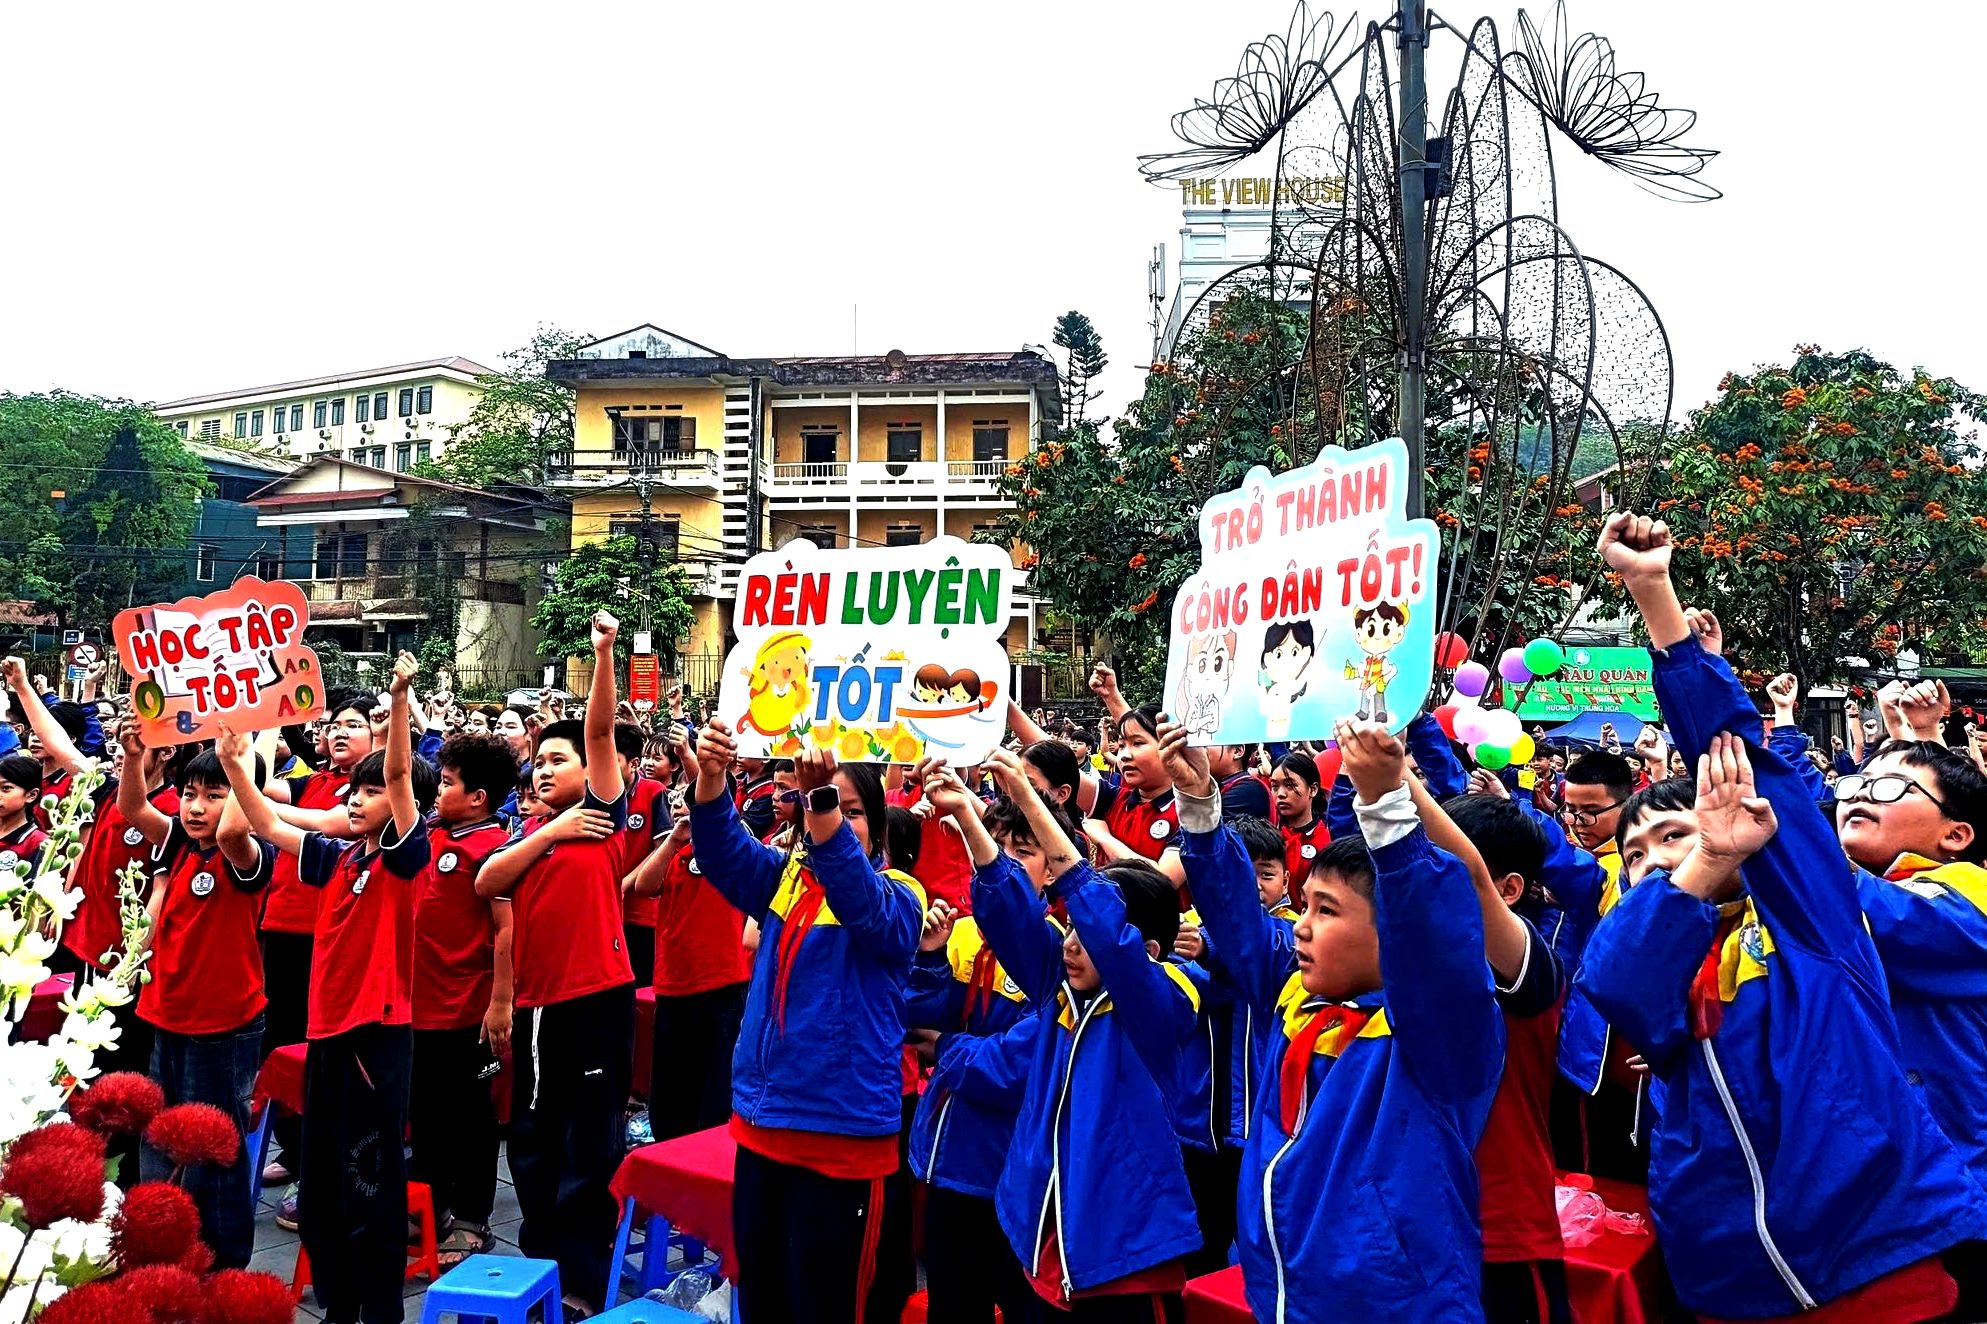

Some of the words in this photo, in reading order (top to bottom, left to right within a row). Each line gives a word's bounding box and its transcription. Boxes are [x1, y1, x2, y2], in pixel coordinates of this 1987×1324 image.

[1179, 178, 1216, 206] THE
[1222, 177, 1272, 205] VIEW
[1277, 176, 1346, 204] HOUSE
[1211, 485, 1264, 554] TRỞ
[1277, 462, 1387, 537] THÀNH
[742, 559, 831, 627] RÈN
[841, 556, 1001, 640] LUYỆN
[1180, 580, 1249, 635] CÔNG
[1261, 559, 1323, 622] DÂN
[1337, 528, 1423, 607] TỐT!
[132, 624, 209, 673] HỌC
[218, 603, 294, 657] TẬP
[186, 654, 259, 713] TỐT
[812, 642, 903, 723] TỐT
